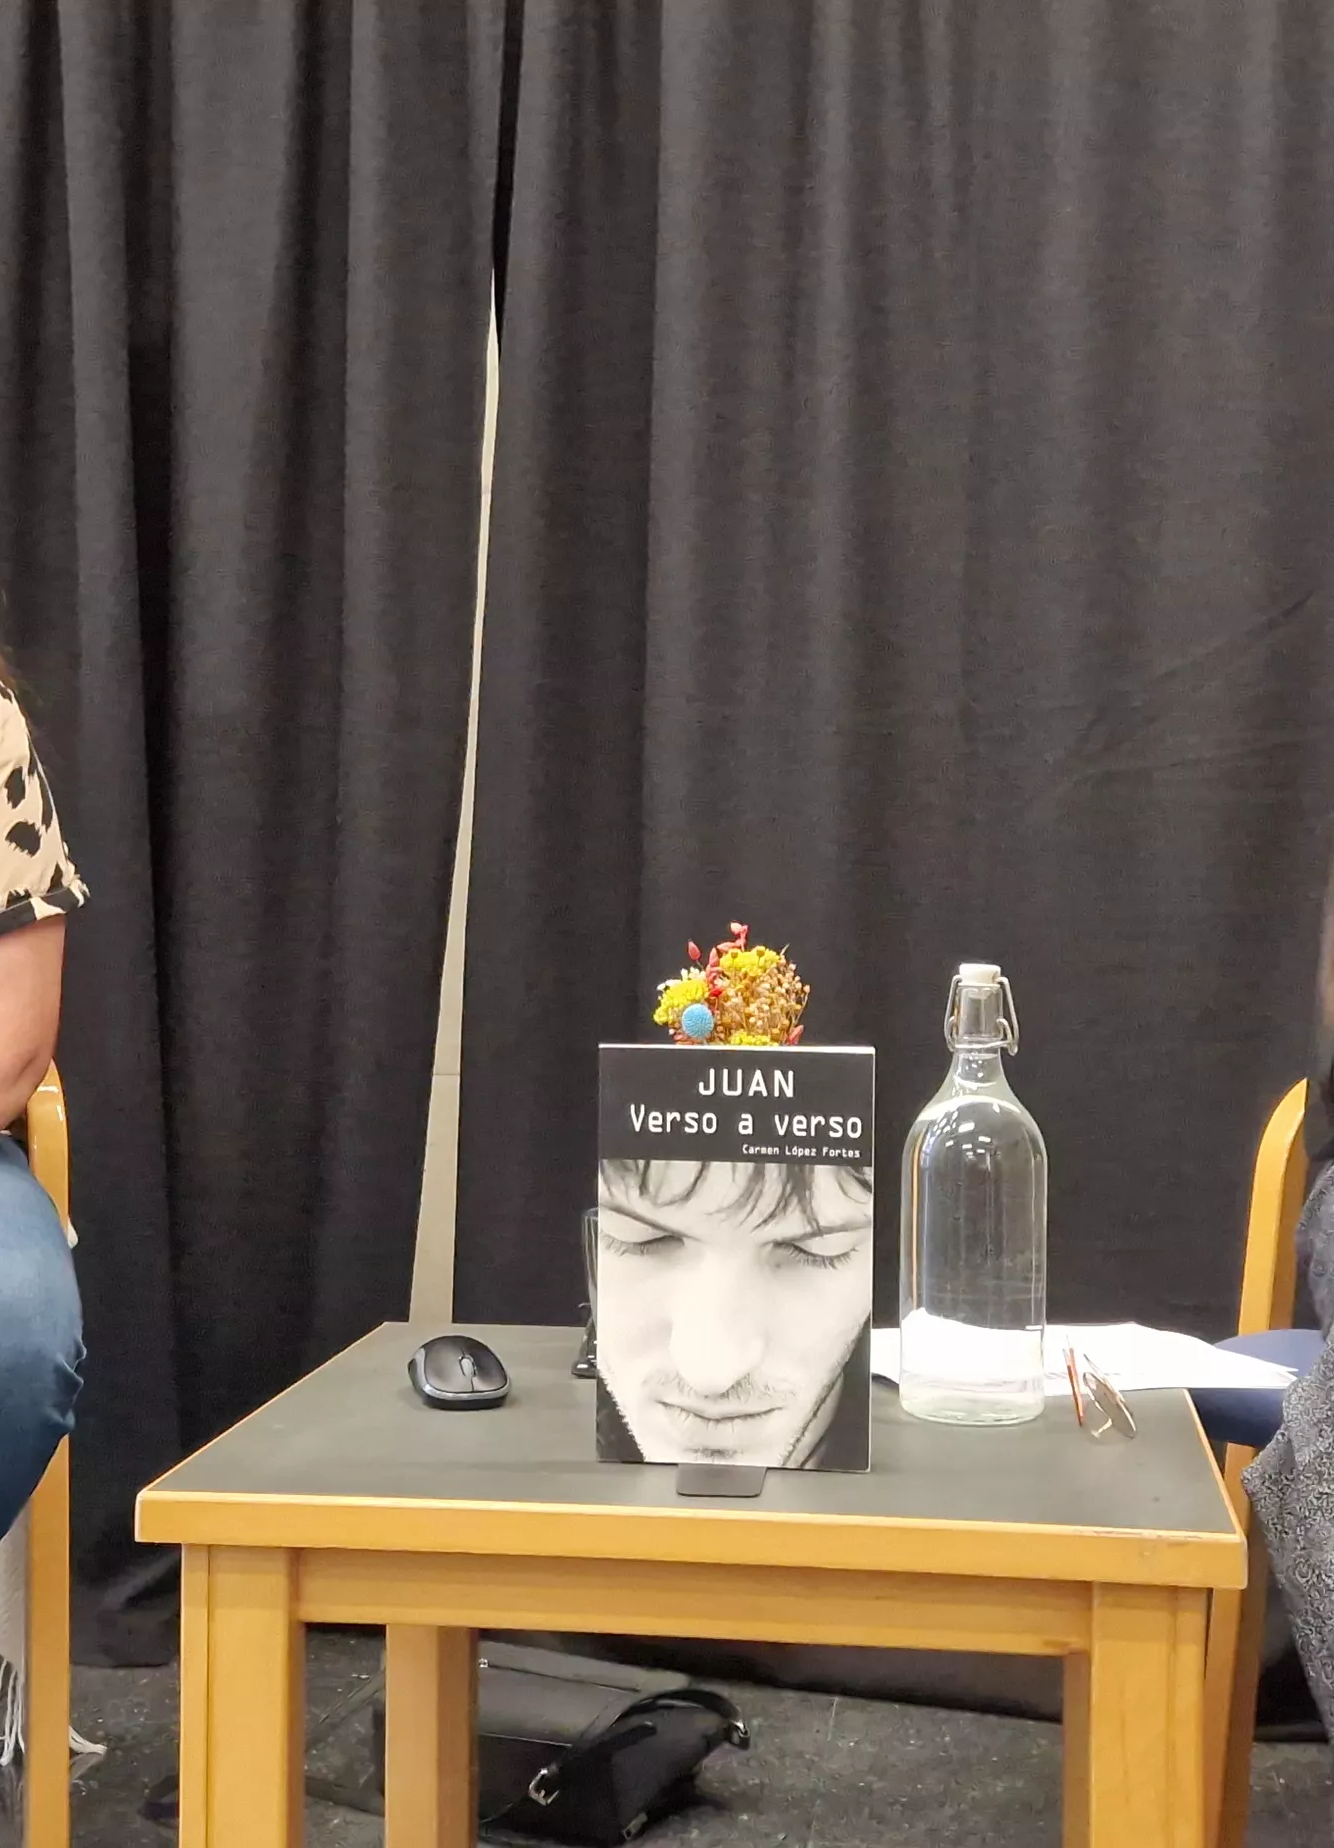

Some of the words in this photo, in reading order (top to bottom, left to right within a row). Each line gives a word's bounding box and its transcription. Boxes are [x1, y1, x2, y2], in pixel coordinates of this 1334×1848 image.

[698, 1068, 794, 1098] JUAN
[630, 1104, 717, 1134] Verso
[738, 1113, 754, 1135] a
[774, 1115, 862, 1139] verso
[742, 1144, 780, 1156] Carmen
[785, 1145, 817, 1158] López
[822, 1146, 861, 1158] Fortes
